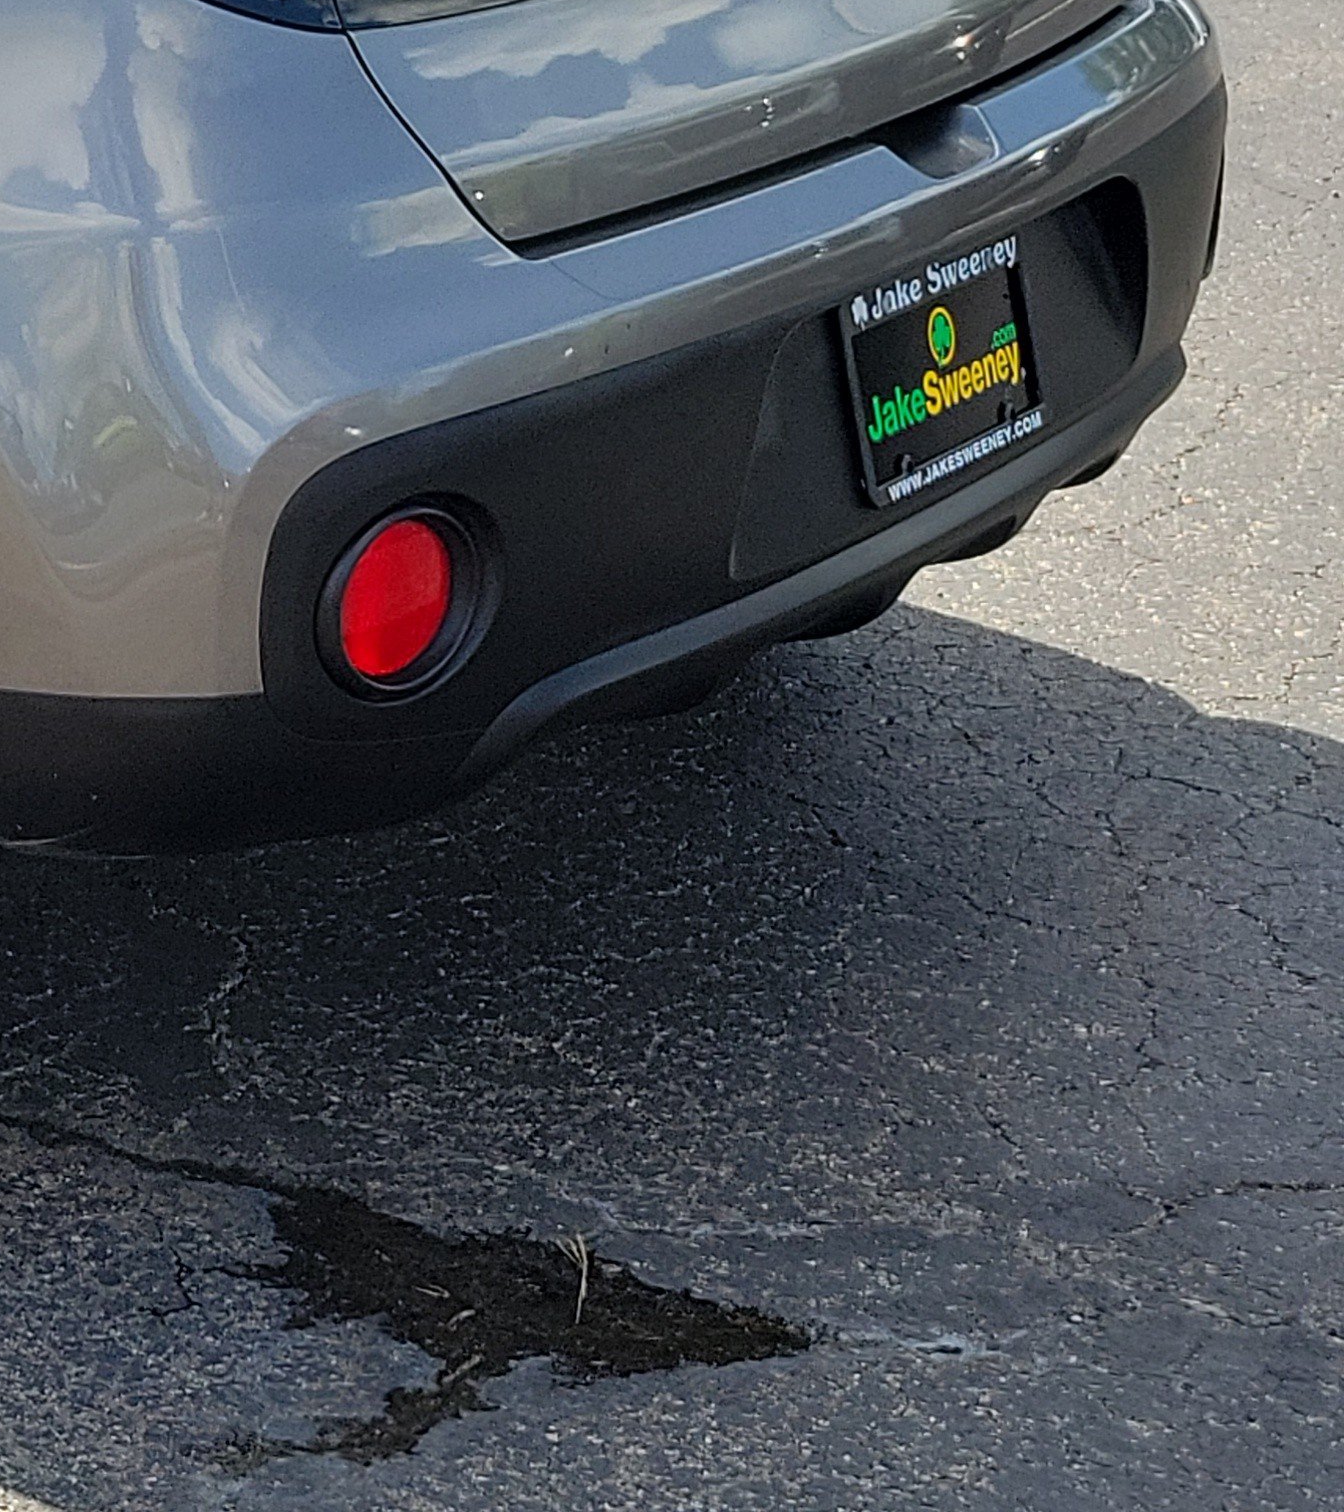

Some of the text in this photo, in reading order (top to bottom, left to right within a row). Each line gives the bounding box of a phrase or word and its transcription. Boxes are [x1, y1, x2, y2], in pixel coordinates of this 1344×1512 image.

[871, 236, 1017, 320] Jake Sweeney
[868, 341, 1021, 444] JakeSweeney
[887, 411, 1043, 502] WWW.JAKESWEENEY.COM
